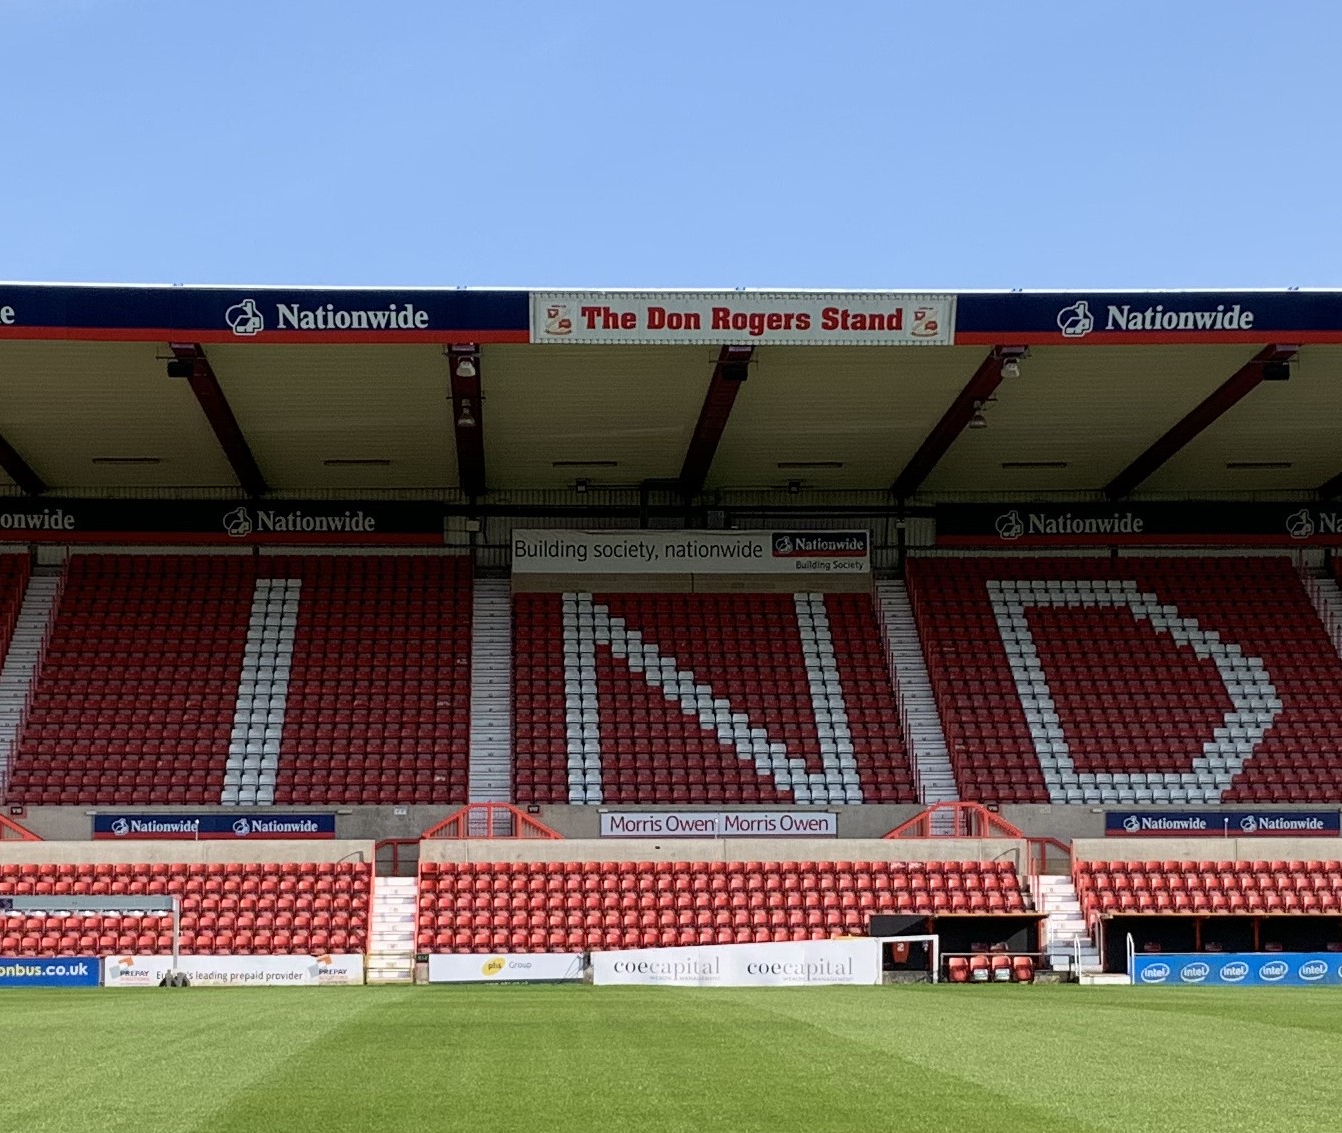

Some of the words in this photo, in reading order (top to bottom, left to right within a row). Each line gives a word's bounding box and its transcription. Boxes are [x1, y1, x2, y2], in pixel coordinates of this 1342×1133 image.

[277, 304, 429, 330] Nationwide
[581, 306, 637, 330] The
[647, 306, 701, 330] Don
[711, 306, 811, 336] Rogers
[821, 306, 903, 331] Stand
[1105, 304, 1254, 331] Nationwide
[257, 510, 376, 532] Nationwide
[1028, 512, 1144, 533] Nationwide
[515, 540, 587, 559] Building
[594, 540, 659, 560] society,
[665, 541, 763, 558] nationwide
[795, 538, 864, 550] Nationwide
[796, 561, 831, 570] Building
[833, 561, 864, 570] Society
[131, 820, 198, 833] Nationwide
[251, 820, 318, 833] Nationwide
[610, 816, 662, 832] Morris
[665, 815, 716, 832] Owen
[724, 815, 776, 832] Morris
[779, 815, 829, 831] Owen
[1142, 817, 1207, 830] Nationwide
[1259, 817, 1324, 830] Nationwide
[509, 961, 532, 970] Group
[614, 956, 720, 981] coecapital
[747, 956, 853, 981] coecapital
[195, 971, 228, 982] leading
[230, 971, 264, 982] prepaid
[266, 970, 303, 982] provider
